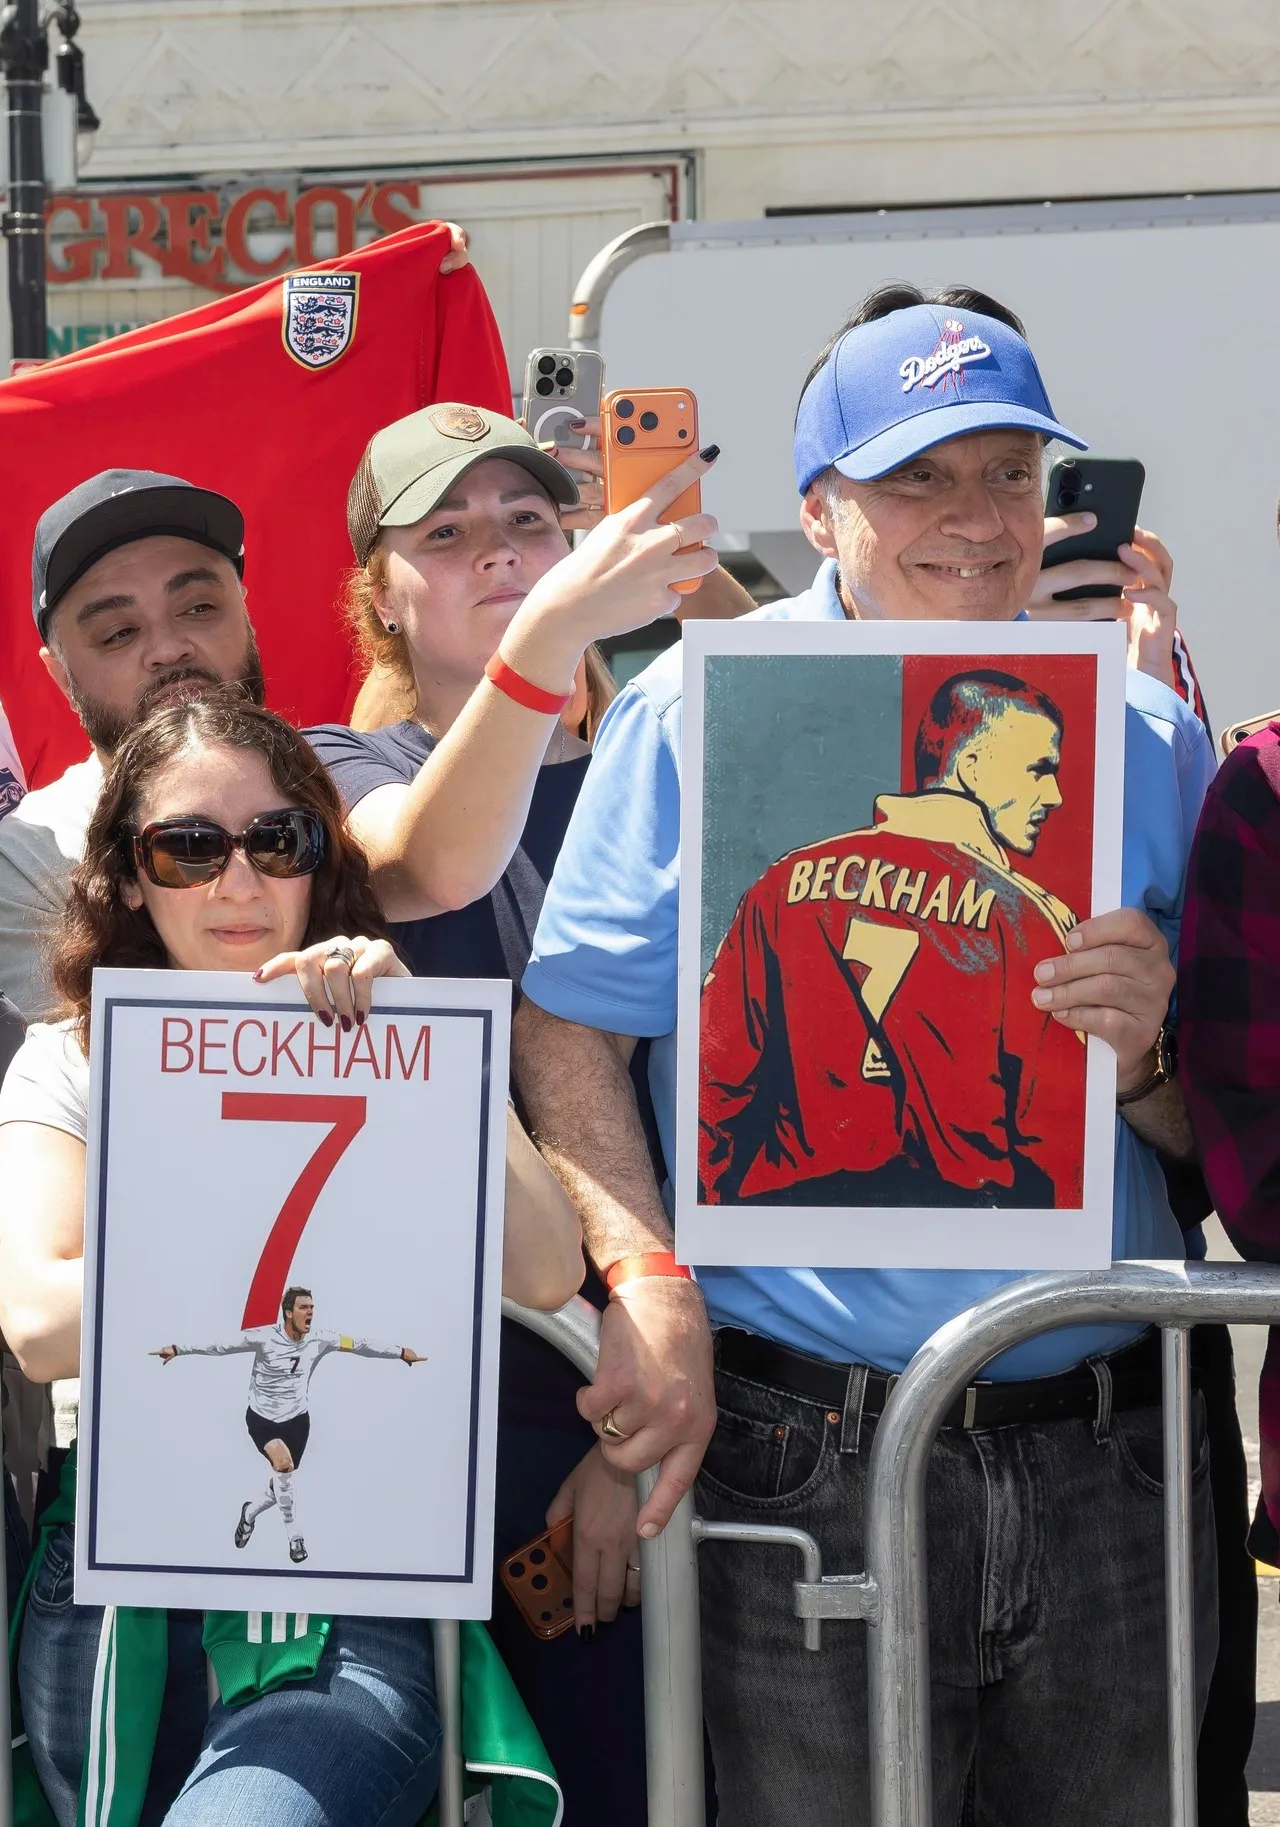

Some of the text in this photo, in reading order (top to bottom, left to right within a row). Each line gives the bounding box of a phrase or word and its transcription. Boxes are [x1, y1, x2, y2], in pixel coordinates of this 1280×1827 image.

[293, 277, 351, 287] ENGLAND
[900, 335, 991, 393] Dodgers
[787, 855, 997, 930] BECKHAM
[842, 918, 920, 1079] 7
[161, 1017, 431, 1081] BECKHAM
[221, 1092, 367, 1331] 7
[290, 1356, 300, 1373] 7
